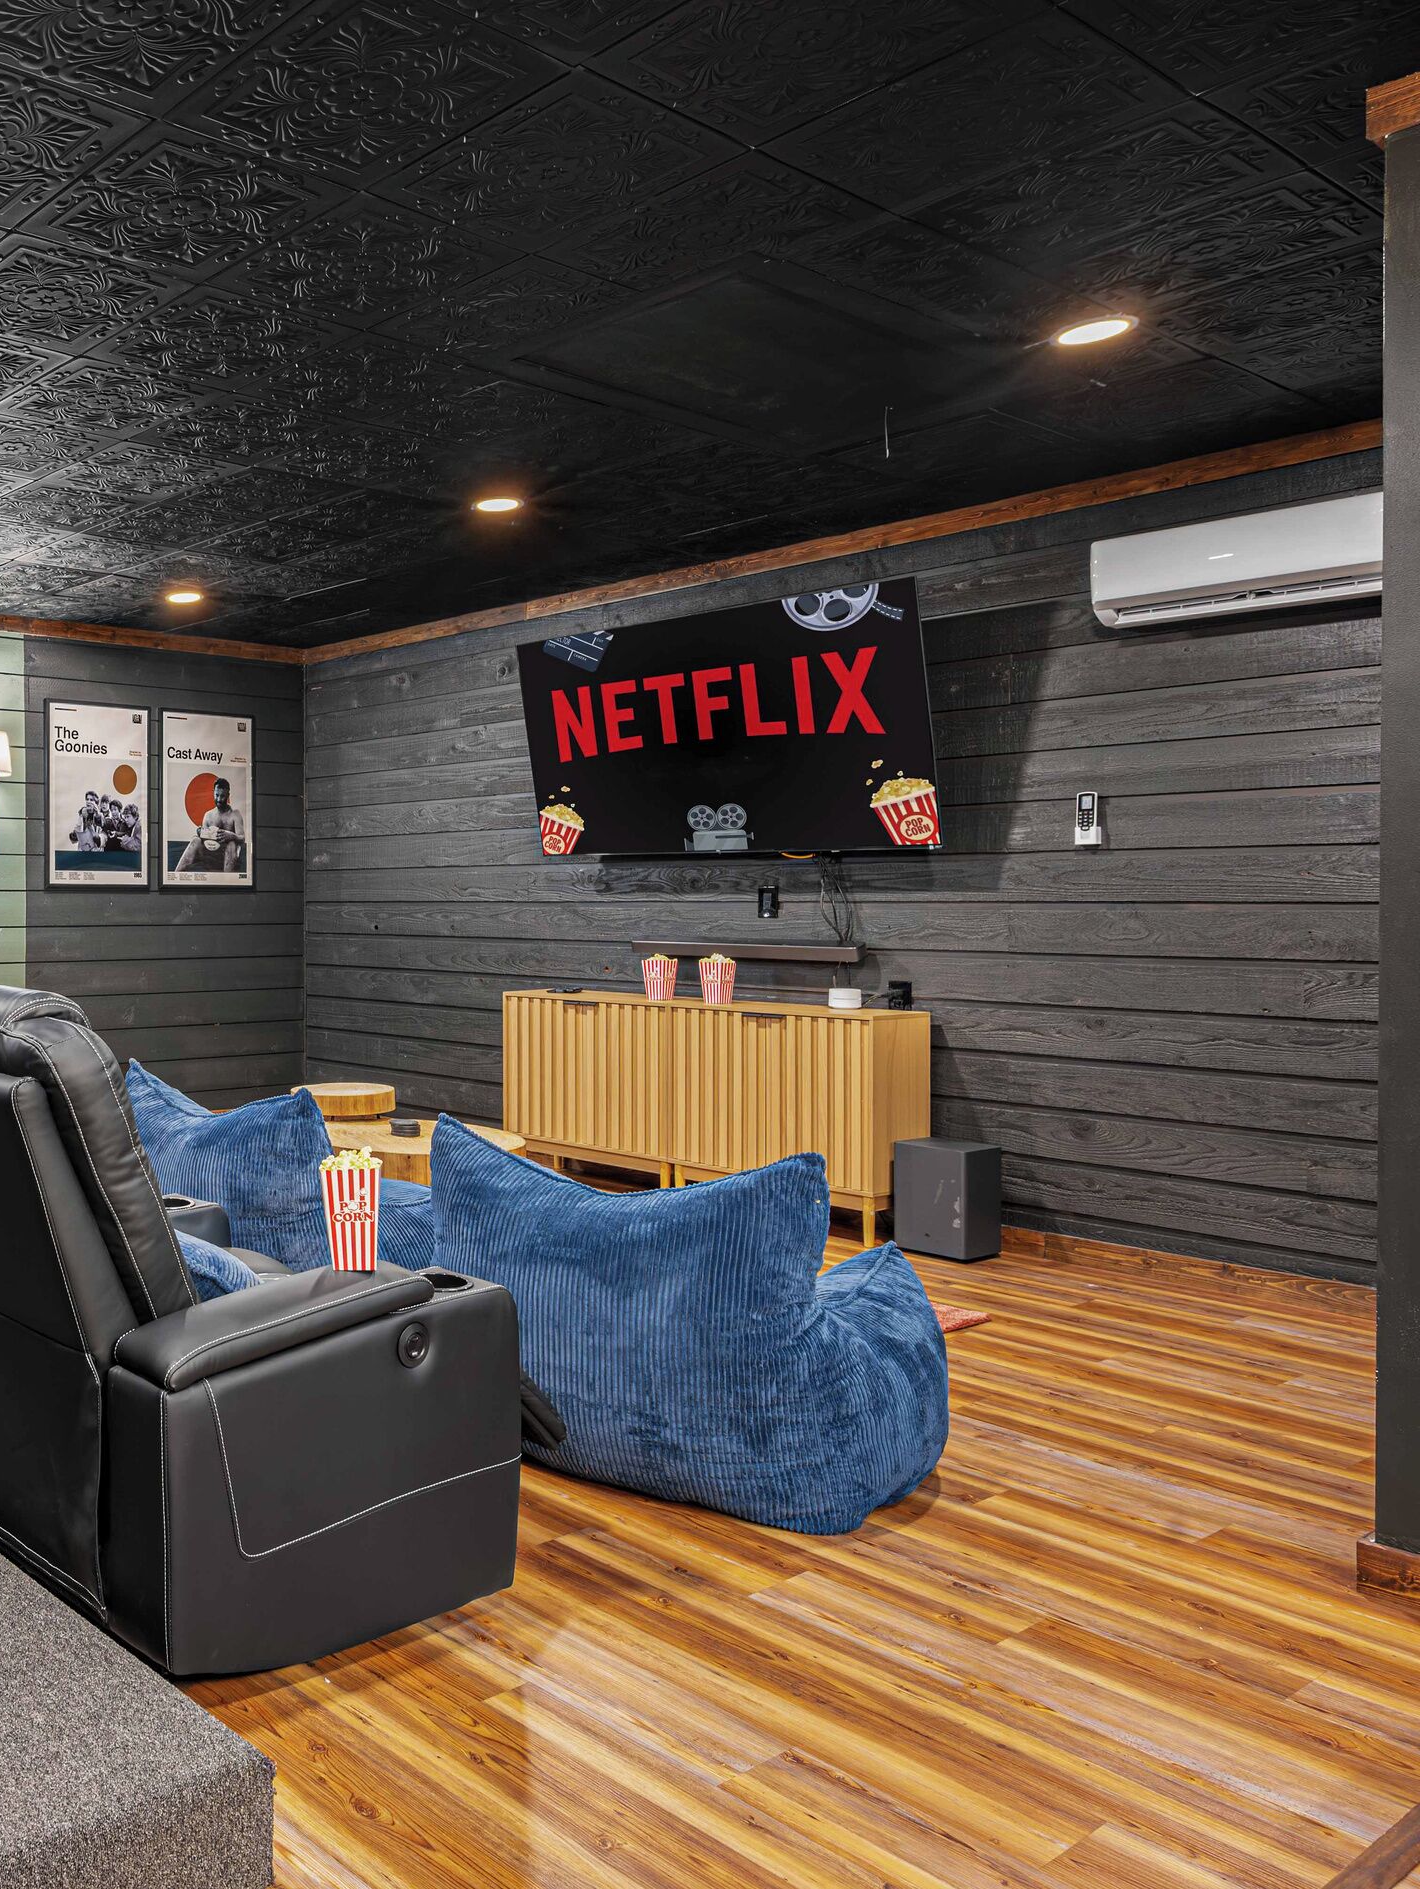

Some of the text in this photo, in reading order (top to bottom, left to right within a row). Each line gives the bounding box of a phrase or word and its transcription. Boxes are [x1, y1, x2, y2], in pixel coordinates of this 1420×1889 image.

[551, 646, 887, 763] NETFLIX
[54, 726, 79, 739] The
[54, 739, 108, 754] Goonies
[167, 746, 223, 764] Cast Away
[905, 817, 924, 829] POP
[905, 823, 931, 837] CORN
[545, 841, 561, 853] CORN
[548, 836, 561, 845] POP
[333, 1212, 374, 1222] CORN
